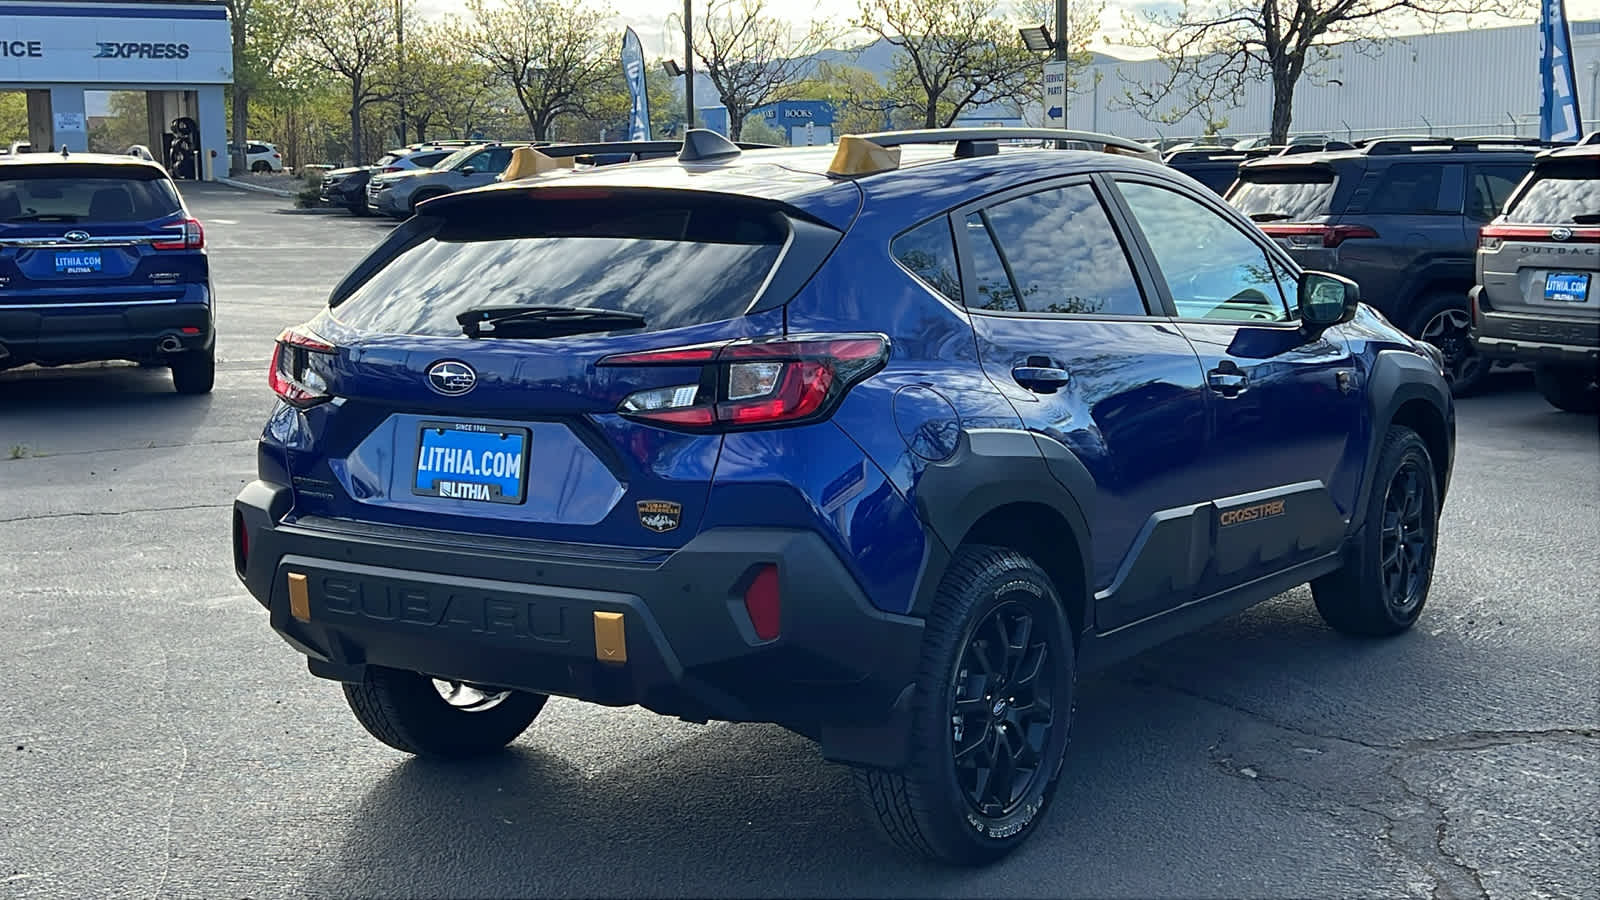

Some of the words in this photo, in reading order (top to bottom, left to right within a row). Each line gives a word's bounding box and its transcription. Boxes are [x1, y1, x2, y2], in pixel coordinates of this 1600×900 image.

[0, 41, 42, 57] ICE
[93, 42, 189, 59] EXPRESS
[1046, 73, 1064, 82] SERVICE
[1047, 87, 1062, 95] PARTS
[784, 109, 813, 118] BOOKS
[1520, 247, 1600, 256] OUTBAC
[55, 256, 102, 267] LITHIA.COM
[1546, 280, 1587, 292] LITHIA.COM
[455, 423, 472, 432] SINCE
[418, 445, 521, 479] LITHIA.COM
[452, 481, 490, 501] LITHIA
[1220, 499, 1285, 525] CROSSTREK
[321, 577, 572, 644] SUBARU
